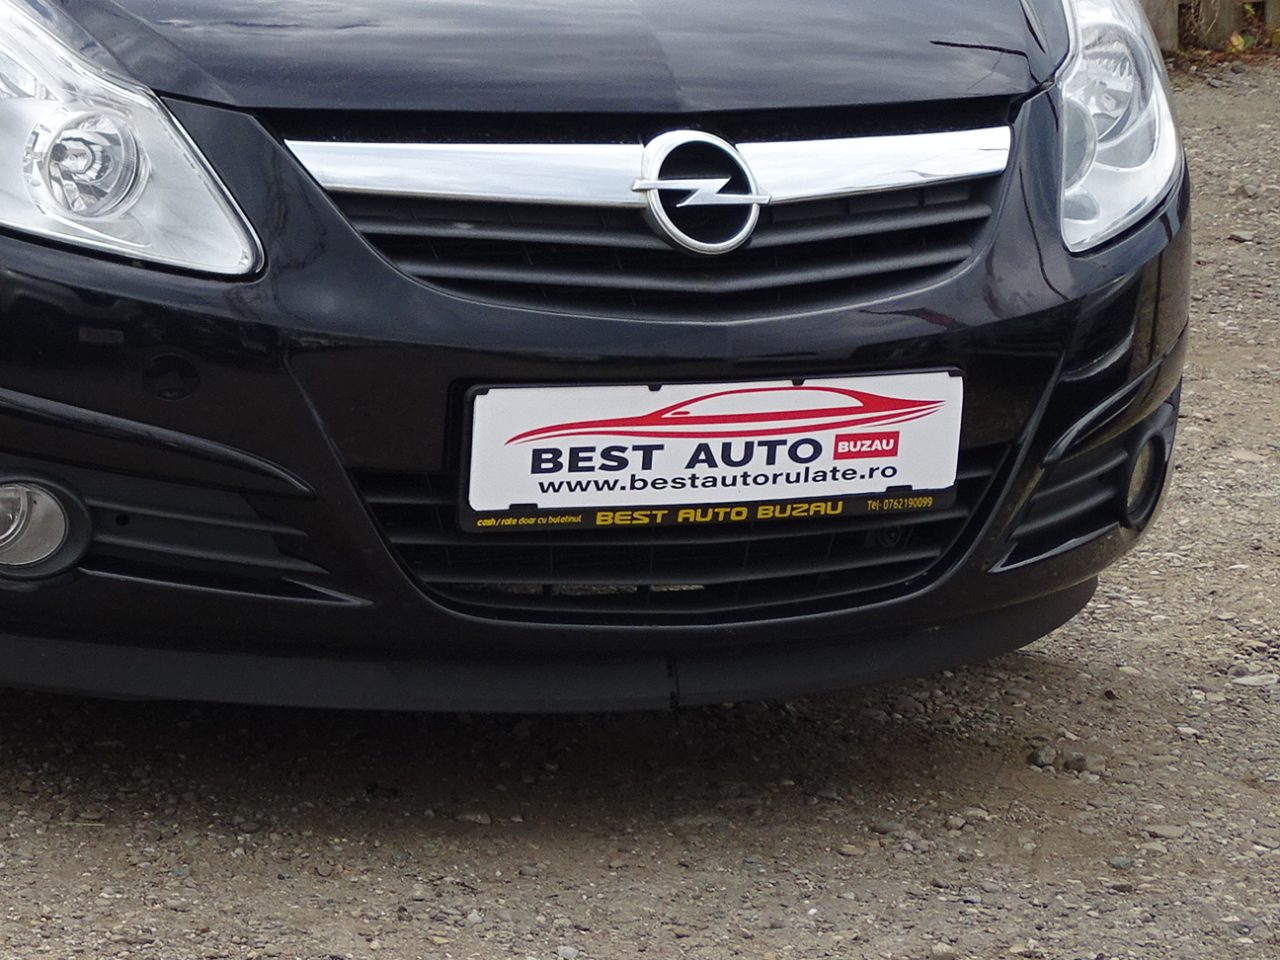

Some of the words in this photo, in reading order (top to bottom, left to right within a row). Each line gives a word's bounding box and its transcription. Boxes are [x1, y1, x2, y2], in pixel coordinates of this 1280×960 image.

[531, 443, 665, 474] BEST
[684, 437, 823, 470] AUTO
[836, 437, 895, 453] BUZAU
[538, 463, 898, 493] www.bestautorulate.ro
[596, 510, 668, 525] BEST
[677, 506, 749, 523] AUTO
[756, 500, 844, 519] BUZAU
